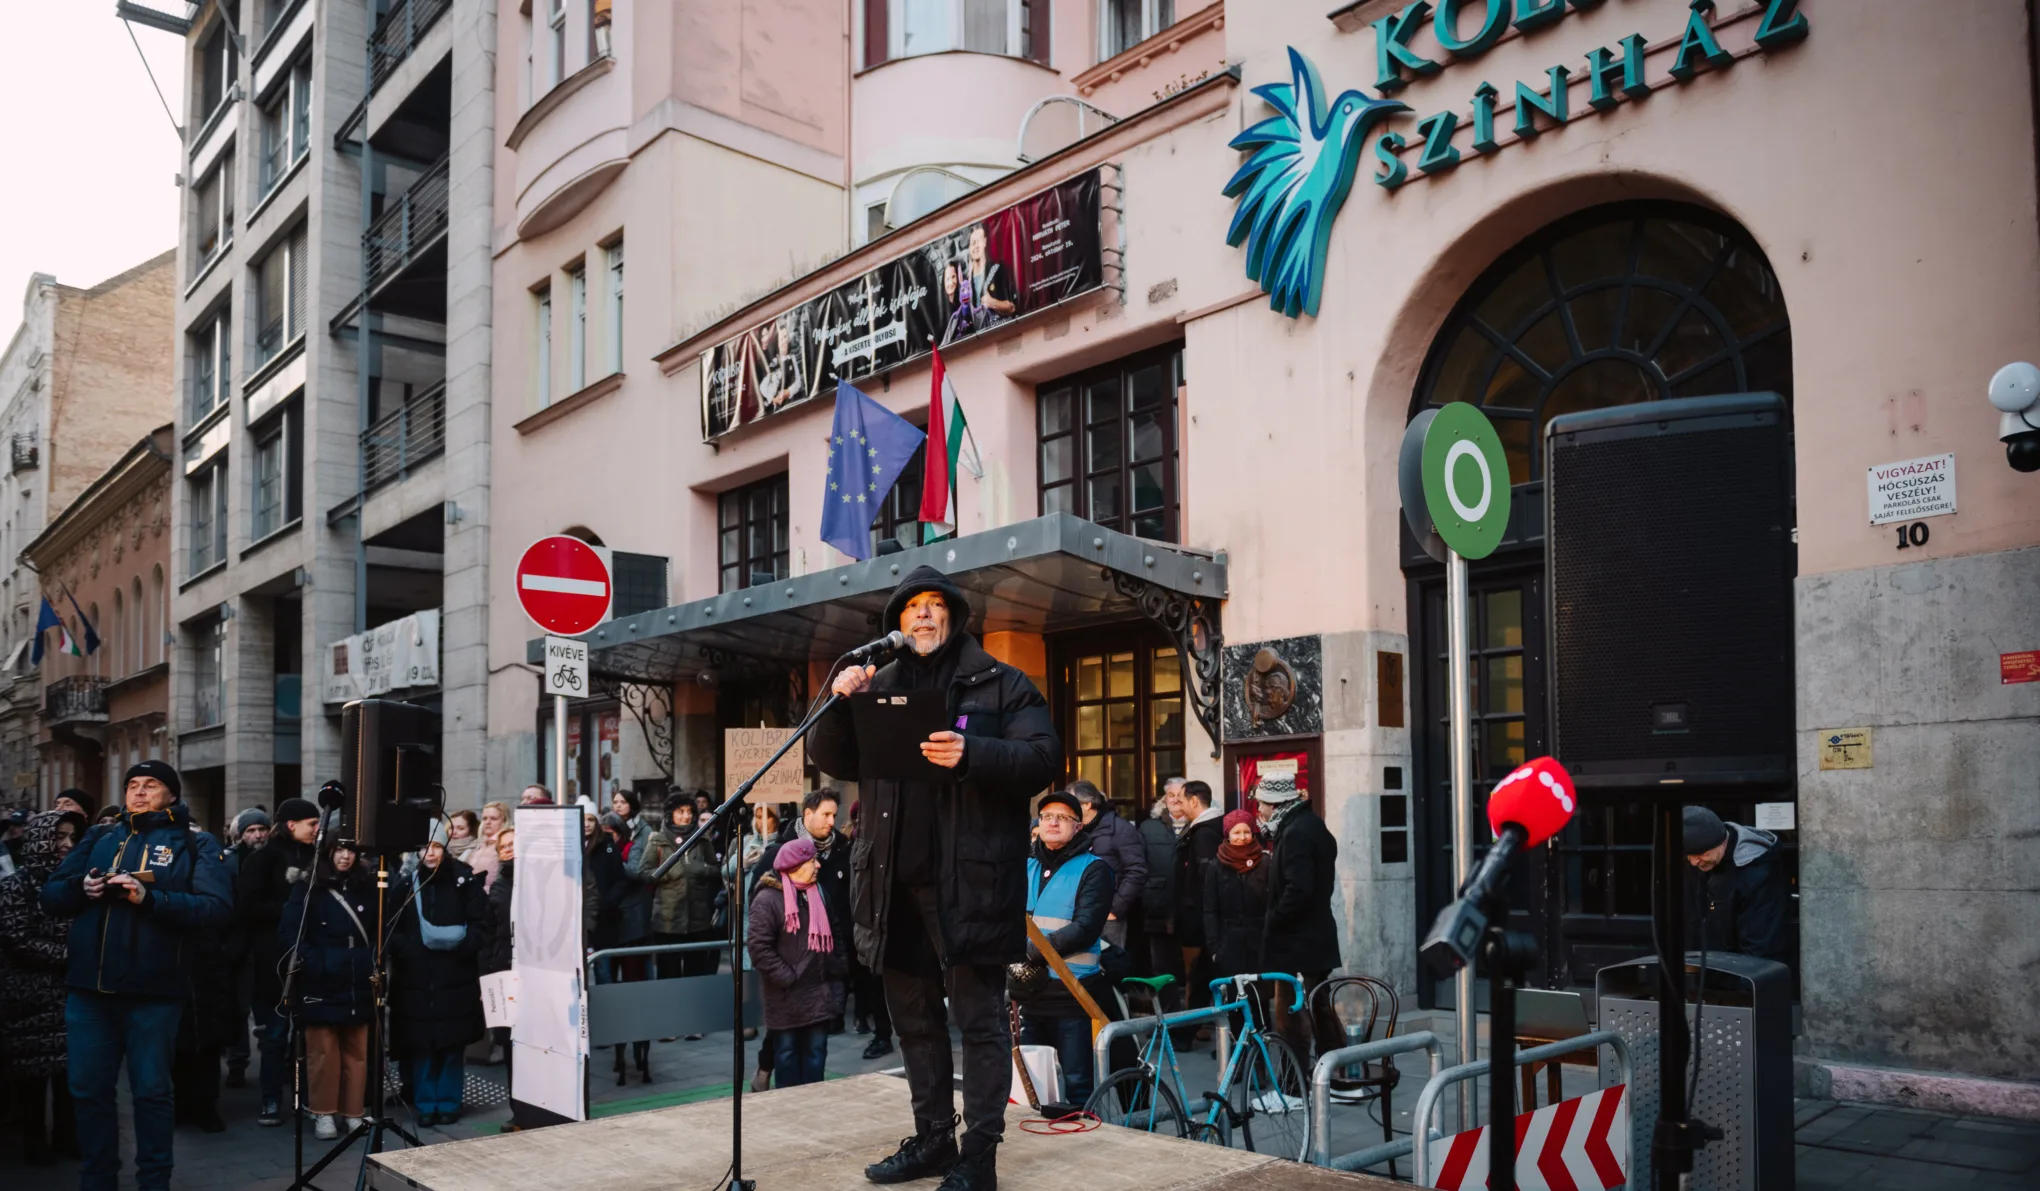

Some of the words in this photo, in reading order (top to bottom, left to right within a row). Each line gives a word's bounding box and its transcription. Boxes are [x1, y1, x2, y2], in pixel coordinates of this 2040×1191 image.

[1374, 0, 1809, 190] SZÍNHÁZ
[1876, 459, 1946, 480] VIGYÁZAT!
[1878, 473, 1945, 492] HÓCSÚSZÁS
[1883, 498, 1921, 510] PARKOLÁS
[1922, 495, 1942, 503] CSAK
[1887, 485, 1937, 501] VESZÉLY!
[1874, 510, 1894, 520] SAJÁT
[1896, 501, 1952, 517] FELELŐSSÉGRE!
[1896, 521, 1930, 550] 10
[549, 645, 584, 661] KIVÉVE
